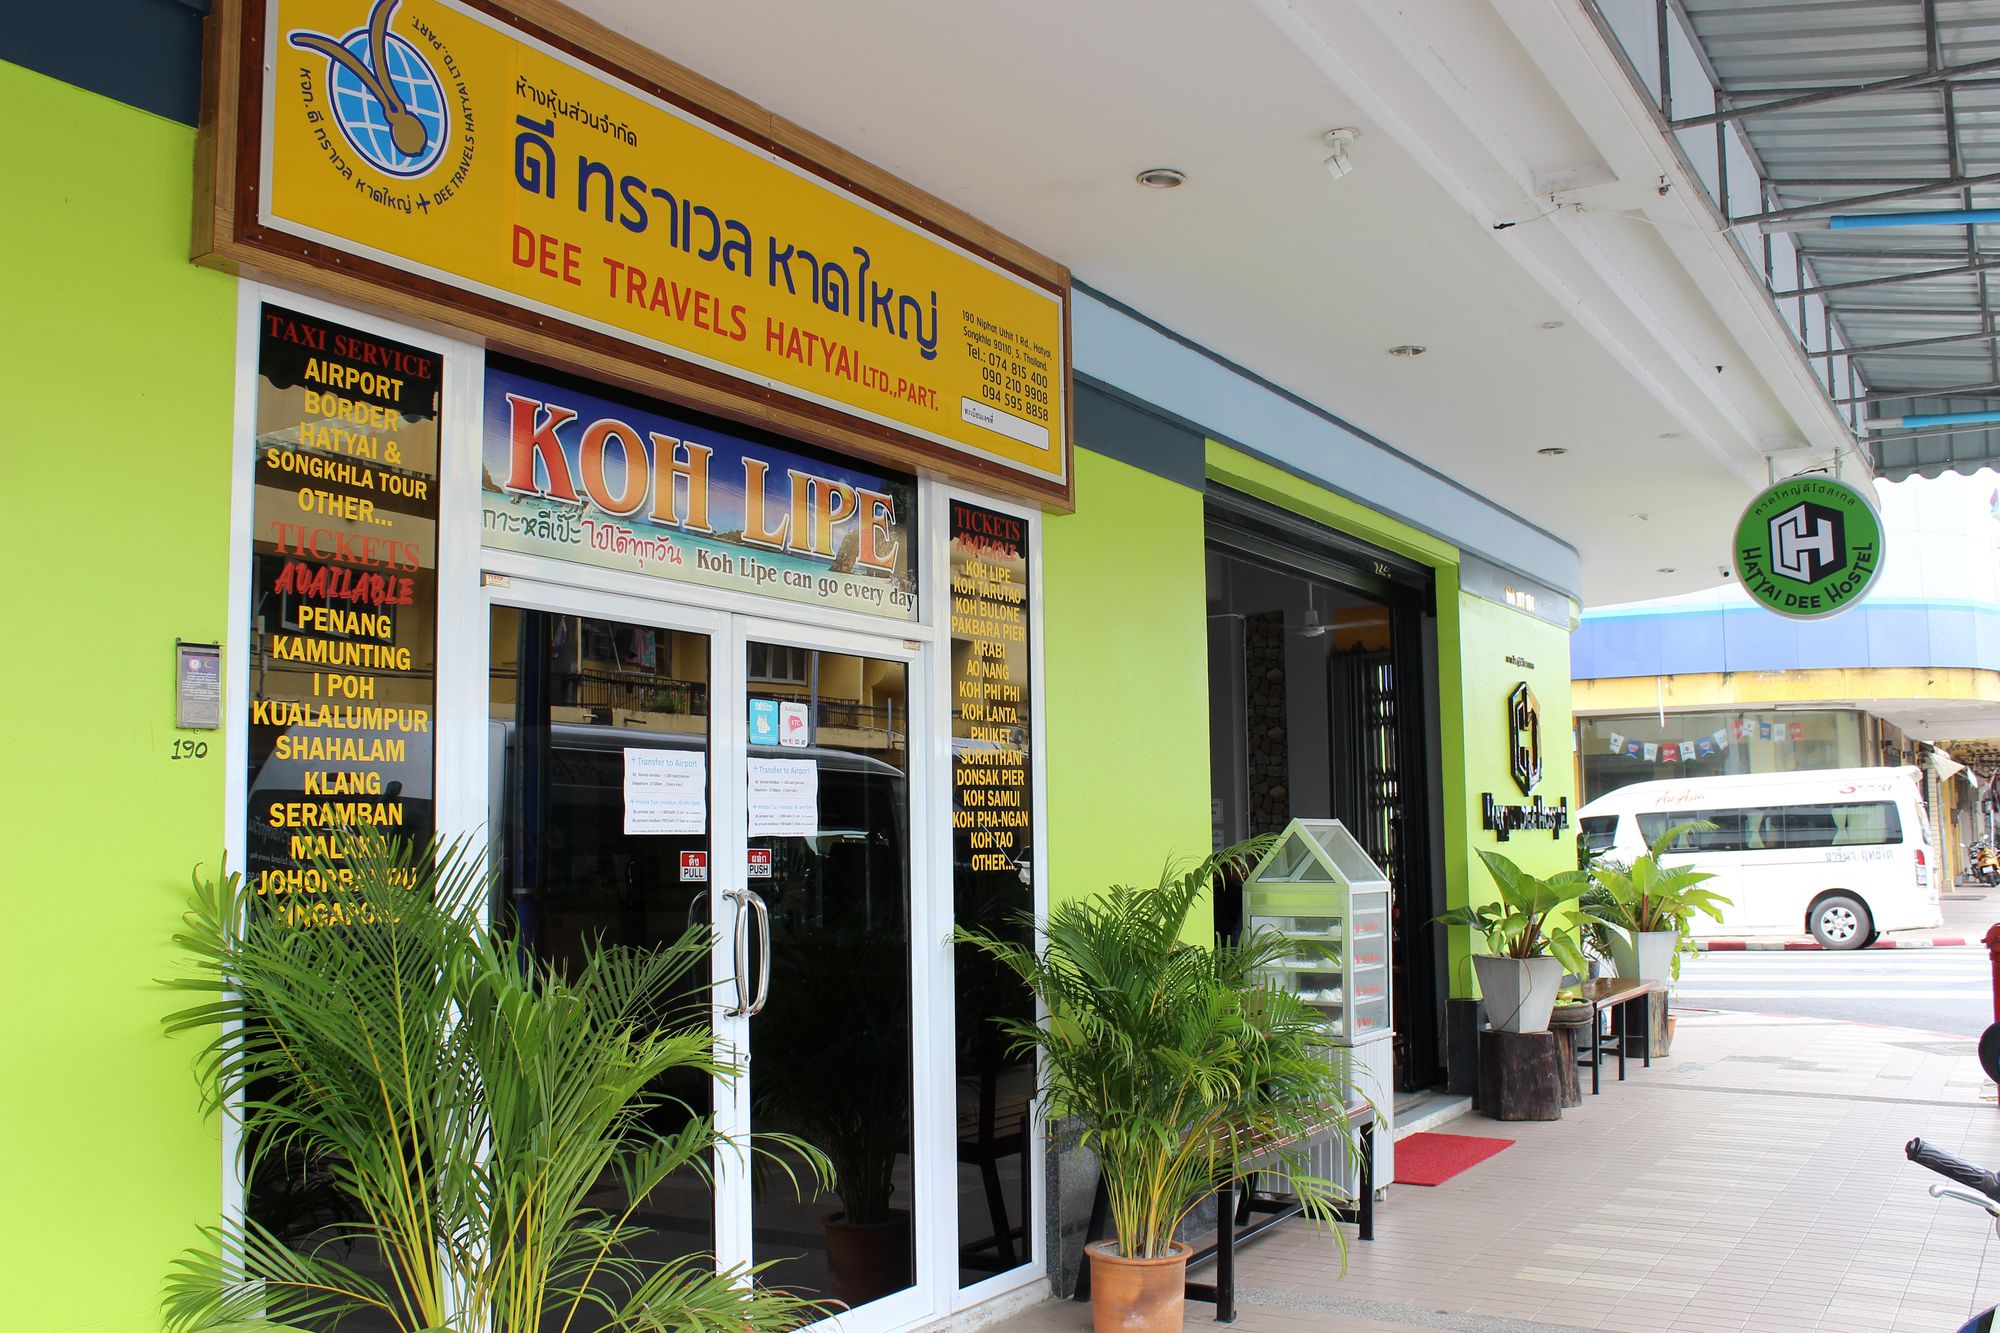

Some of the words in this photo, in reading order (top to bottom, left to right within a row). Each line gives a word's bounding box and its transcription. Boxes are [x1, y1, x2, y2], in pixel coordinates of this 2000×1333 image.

[455, 82, 476, 132] HATYAI
[516, 75, 637, 147] ห้างหุ้นส่วนจำกัด
[314, 127, 353, 180] ทราเวล
[356, 177, 412, 214] หาดใหญ่
[450, 134, 476, 190] TRAVELS
[434, 188, 454, 206] DEE
[515, 115, 556, 199] ดี
[577, 154, 752, 277] ทราเวล
[769, 246, 938, 361] หาดใหญ่
[512, 224, 582, 287] DEE
[603, 256, 747, 342] TRAVELS
[765, 316, 859, 382] HATYAI
[962, 310, 975, 324] 190
[976, 316, 998, 334] Niphat
[999, 327, 1014, 342] Uthit
[1015, 334, 1019, 343] 1
[963, 326, 992, 347] Songkhla
[266, 313, 326, 351] TAXI
[334, 333, 432, 380] SERVICE
[304, 357, 404, 402] AIRPORT
[982, 366, 1002, 386] 090
[1005, 376, 1022, 394] 210
[1024, 384, 1048, 405] 9908
[988, 352, 1007, 371] 074
[1011, 362, 1027, 380] 815
[1030, 371, 1048, 389] 400
[304, 390, 399, 432] BORDER
[982, 384, 1001, 403] 094
[1004, 393, 1023, 411] 595
[1025, 401, 1049, 422] 8858
[299, 421, 377, 460] HATYAI
[383, 440, 401, 465] &
[266, 447, 374, 489] SONGKHLA
[378, 472, 428, 500] TOUR
[504, 392, 713, 534] KOH
[740, 456, 899, 574] LIPE
[298, 487, 393, 527] OTHER...
[483, 509, 582, 544] กาะหลีเป๊ะ
[955, 507, 1020, 542] TICKETS
[270, 520, 420, 573] TICKETS
[274, 562, 415, 607] AVAILABLE
[697, 547, 734, 575] Koh
[740, 557, 777, 589] Lipe
[783, 570, 813, 592] can
[818, 576, 839, 597] go
[843, 581, 884, 606] every
[889, 588, 916, 613] day
[966, 560, 987, 579] KOH
[990, 566, 1011, 585] LIPE
[1742, 546, 1782, 602] HATYAI
[1784, 592, 1822, 609] DEE
[1824, 542, 1873, 603] HOSTEL
[953, 576, 976, 596] KOH
[978, 581, 1021, 605] TARUTAO
[298, 604, 392, 639] PENANG
[955, 597, 977, 616] KOH
[980, 600, 1020, 623] BULONE
[952, 616, 1000, 639] PAKBARA
[1003, 623, 1025, 642] PIER
[272, 635, 411, 671] KAMUNTING
[974, 639, 1006, 659] KRABI
[966, 659, 980, 677] AO
[982, 661, 1009, 681] NANG
[327, 674, 375, 700] POH
[959, 681, 981, 699] KOH
[983, 683, 1000, 701] PHI
[1003, 685, 1020, 702] PHI
[252, 700, 428, 733] KUALALUMPUR
[962, 703, 983, 721] KOH
[986, 706, 1017, 724] LANTA
[171, 738, 208, 760] 190
[275, 734, 406, 763] SHAHALAM
[971, 726, 1012, 745] PHUKET
[637, 757, 664, 767] Transfer
[666, 759, 674, 767] to
[675, 759, 698, 769] Airport
[759, 765, 782, 774] Transfer
[791, 767, 810, 776] Airport
[961, 748, 1023, 766] SURATTHANI
[304, 771, 382, 796] KLANG
[956, 768, 1000, 786] DONSAK
[1001, 769, 1025, 786] PIER
[963, 789, 985, 807] KOH
[987, 789, 1020, 807] SAMUI
[269, 802, 403, 828] SERAMBAN
[953, 811, 974, 828] KOH
[977, 811, 1029, 828] PHA-NGAN
[971, 832, 992, 849] KOH
[994, 831, 1013, 848] TAO
[683, 868, 703, 878] PULL
[750, 864, 768, 874] PUSH
